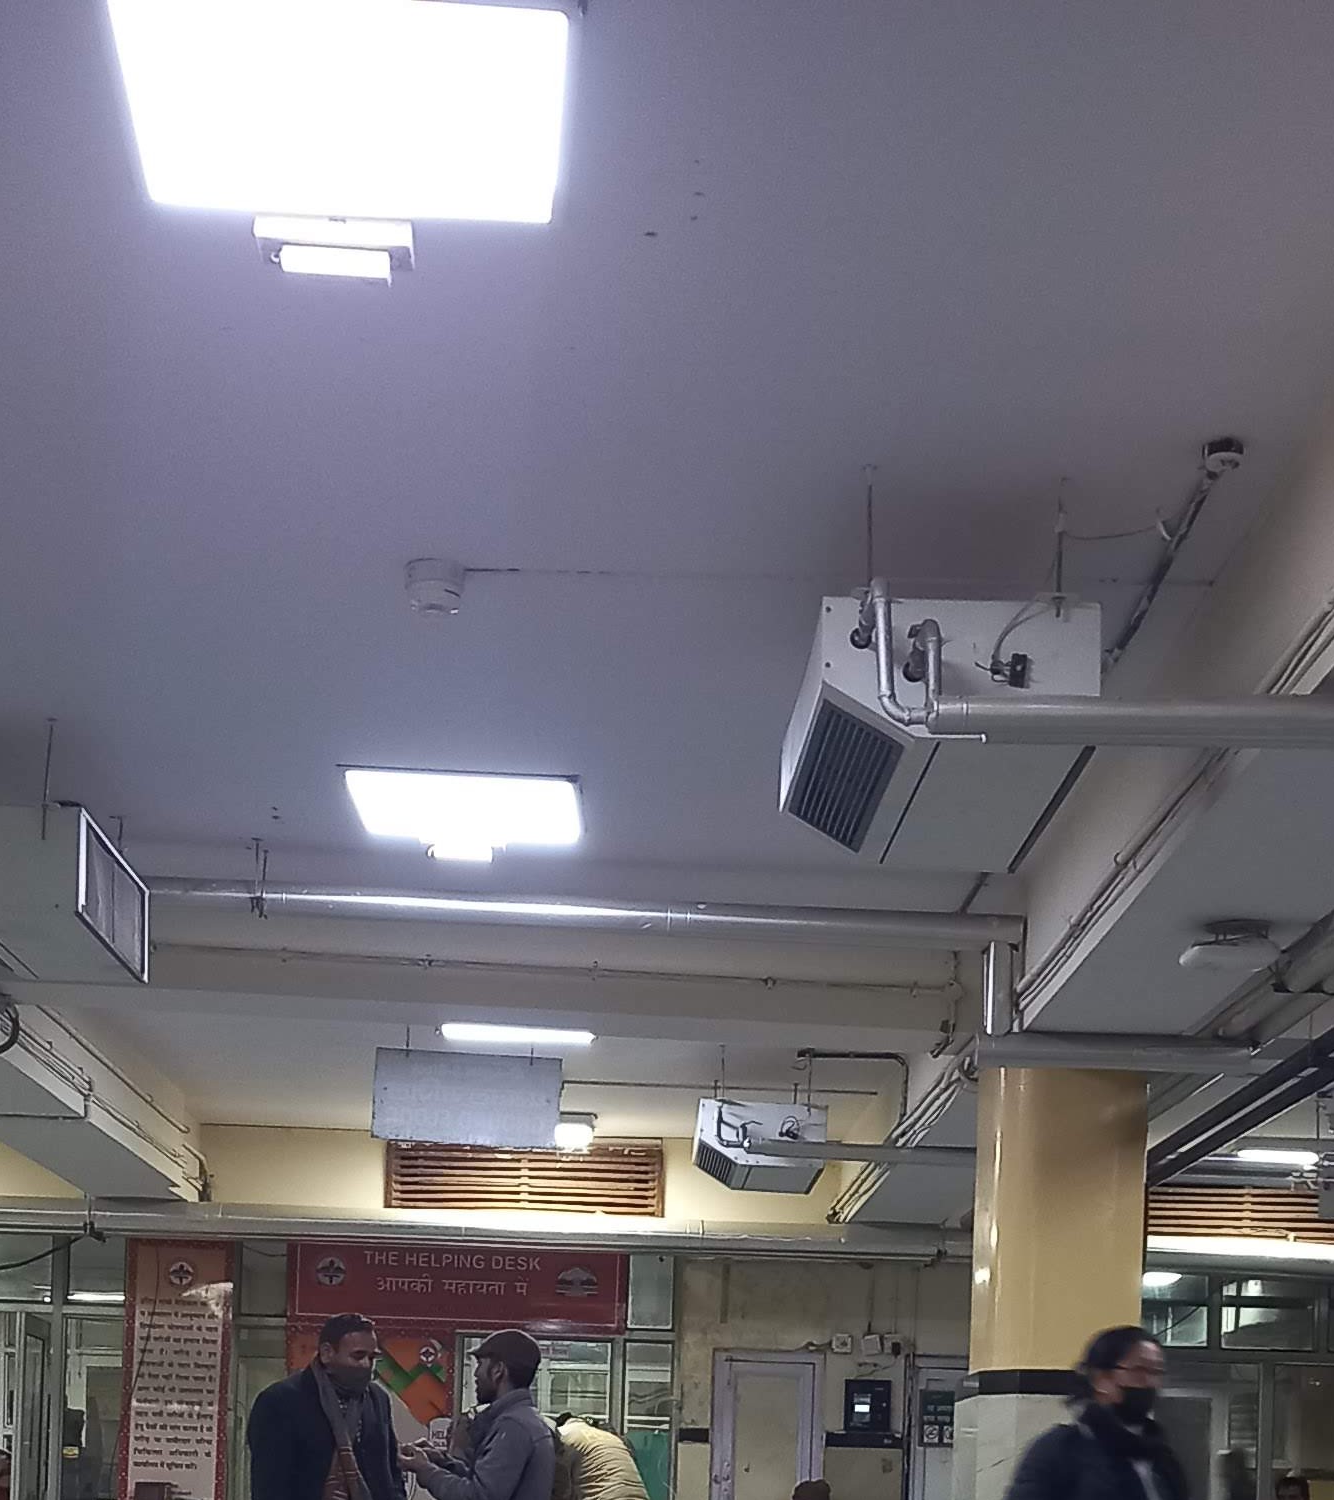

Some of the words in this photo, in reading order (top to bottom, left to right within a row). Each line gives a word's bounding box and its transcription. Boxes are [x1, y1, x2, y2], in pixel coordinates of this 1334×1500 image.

[364, 1250, 399, 1266] THE
[405, 1252, 485, 1270] HELPING
[491, 1255, 542, 1271] DESK
[376, 1273, 434, 1294] आपकी
[441, 1279, 506, 1296] सहायता
[514, 1275, 529, 1297] में
